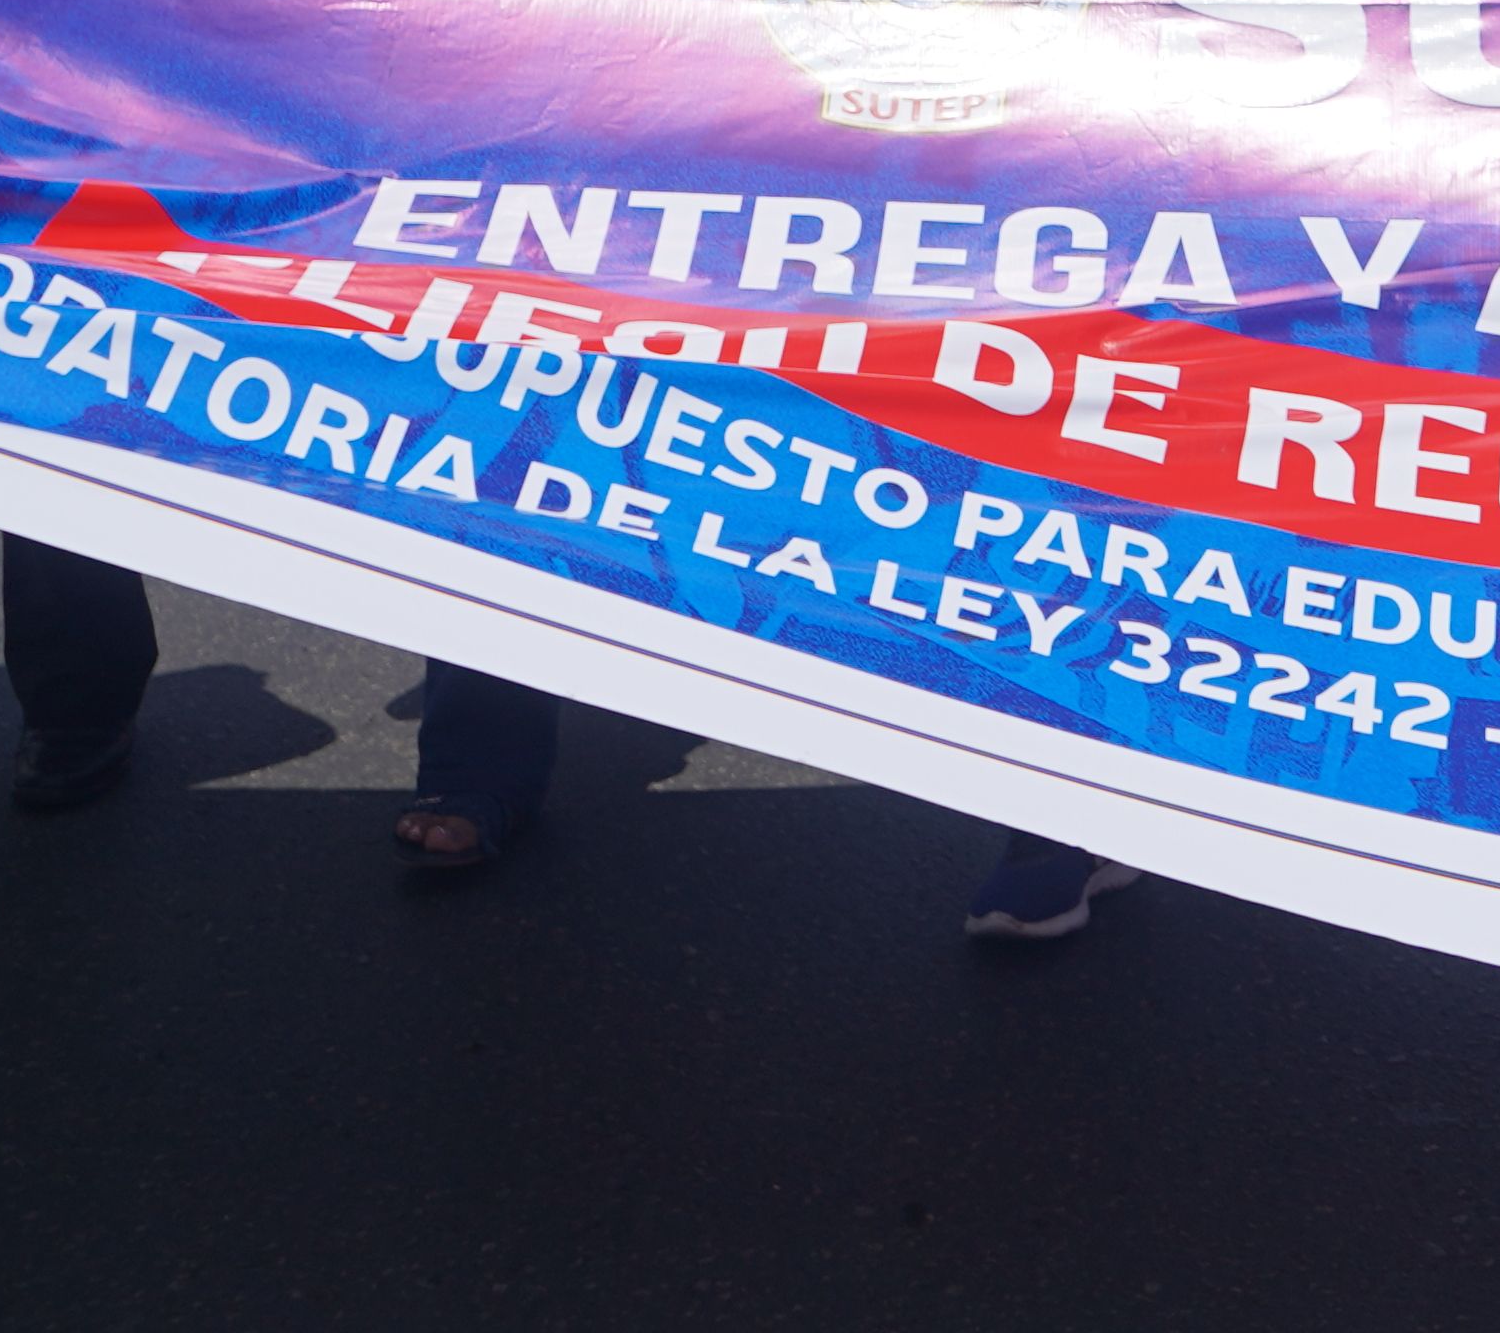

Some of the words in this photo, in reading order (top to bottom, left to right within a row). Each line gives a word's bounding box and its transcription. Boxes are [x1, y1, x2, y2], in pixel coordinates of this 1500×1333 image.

[841, 89, 988, 124] SUTEP
[353, 177, 1239, 309] ENTREGA
[1301, 216, 1425, 309] Y
[931, 319, 1182, 465] DE
[515, 461, 672, 542] DE
[692, 511, 838, 597] LA
[867, 559, 1087, 658] LEY
[1108, 620, 1451, 751] 32242
[953, 491, 1253, 619] PARA
